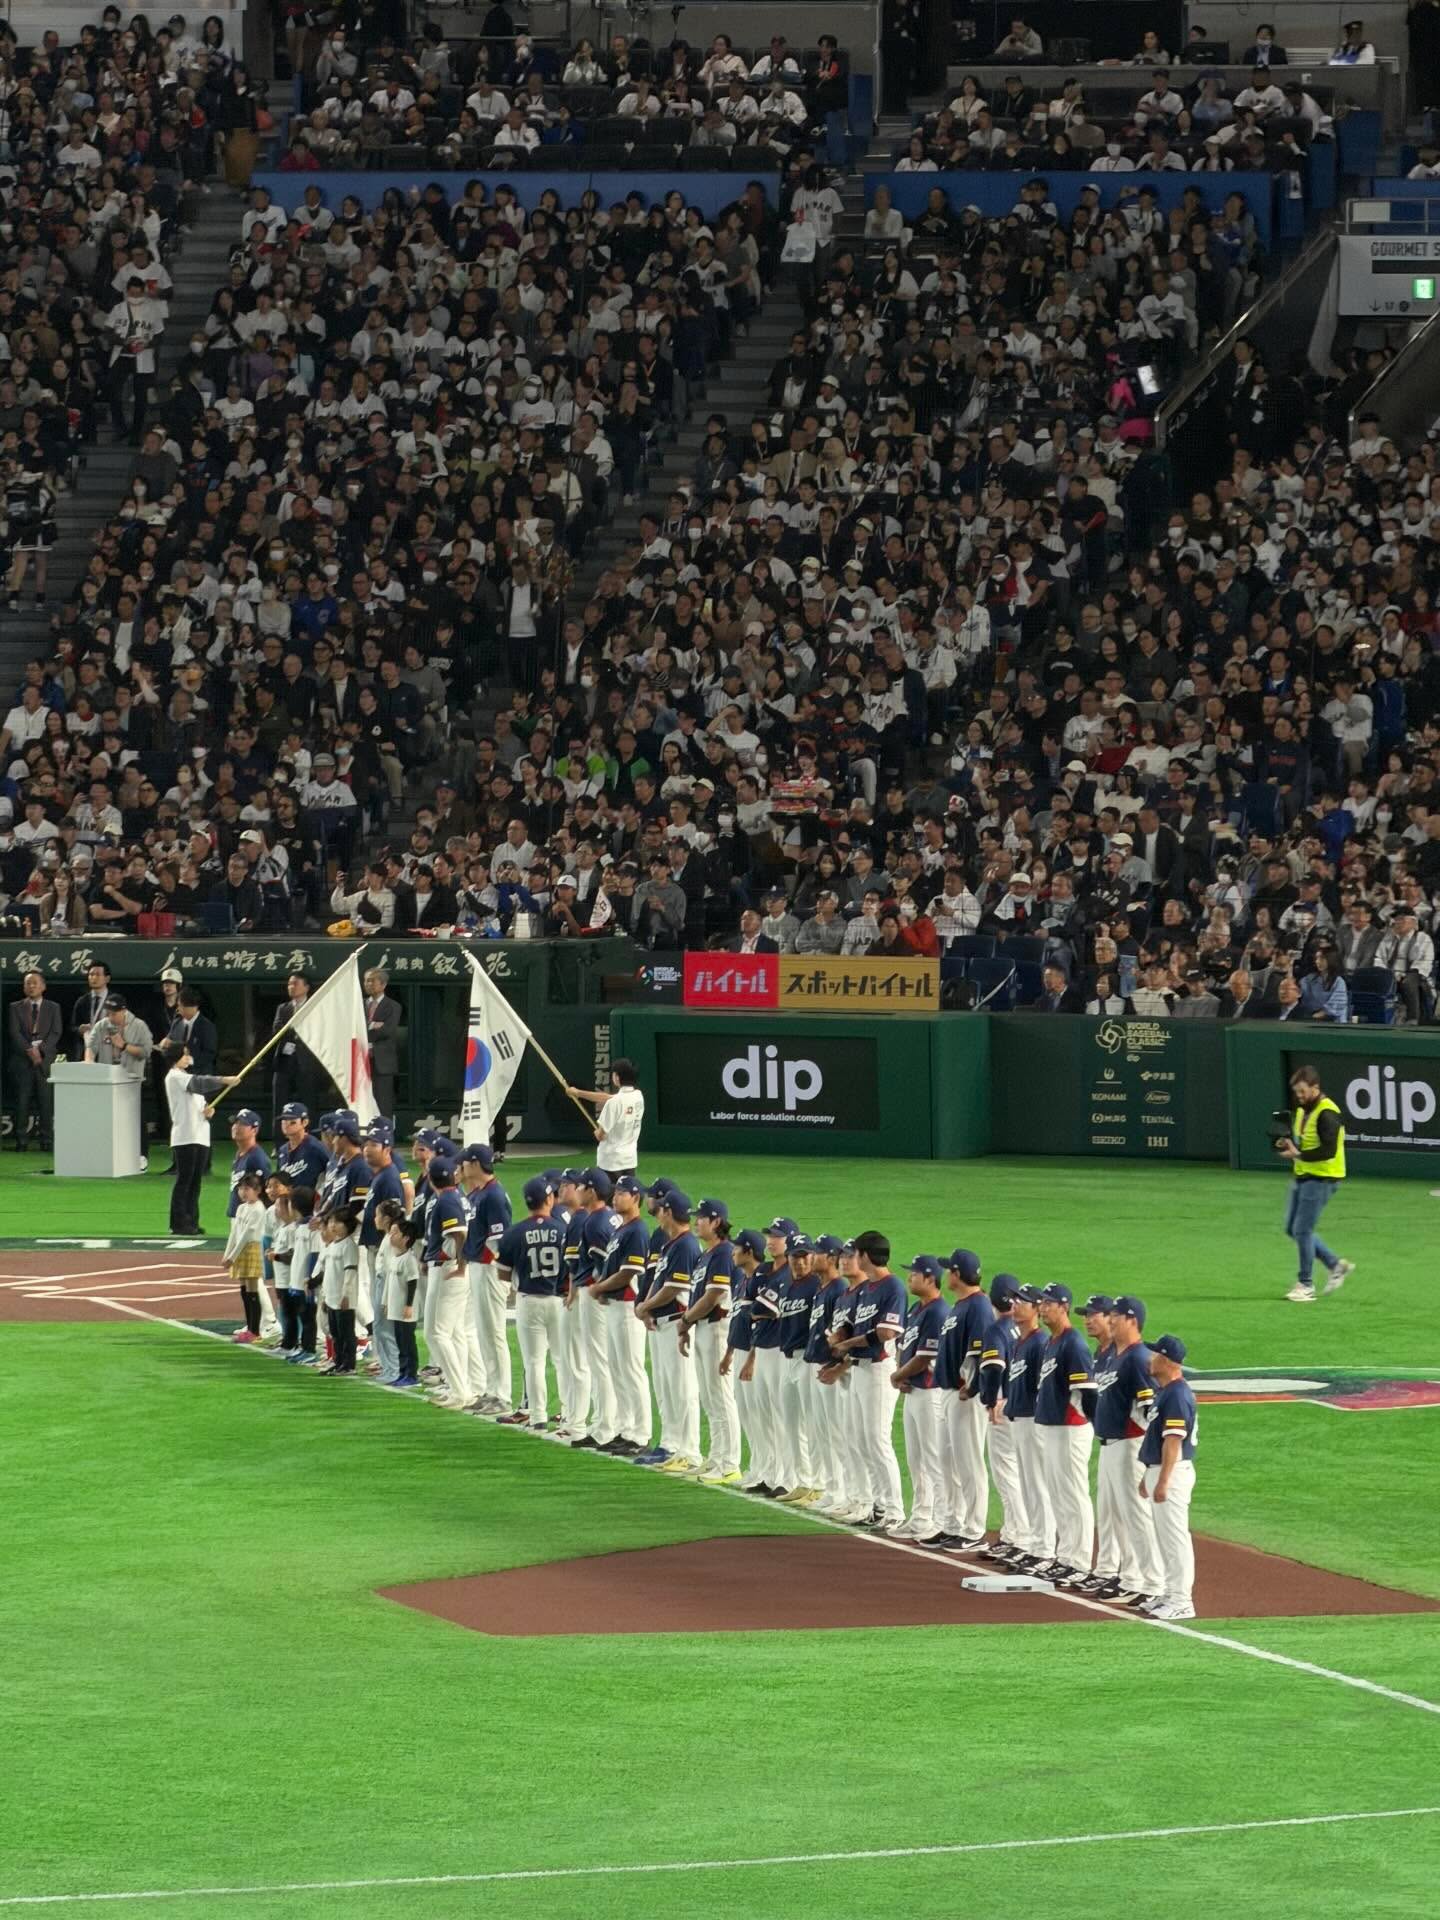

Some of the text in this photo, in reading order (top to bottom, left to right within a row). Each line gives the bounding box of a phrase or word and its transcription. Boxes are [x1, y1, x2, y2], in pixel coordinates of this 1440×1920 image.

[1371, 242, 1428, 256] GOURMET
[694, 968, 769, 993] バイトル
[784, 970, 934, 997] スポットバイトル
[1126, 1022, 1160, 1030] WORLD
[722, 1045, 823, 1110] dip
[1345, 1065, 1436, 1132] dip
[710, 1111, 835, 1124] Labor force solution company
[1147, 1136, 1169, 1147] IHI
[527, 1246, 560, 1279] 19
